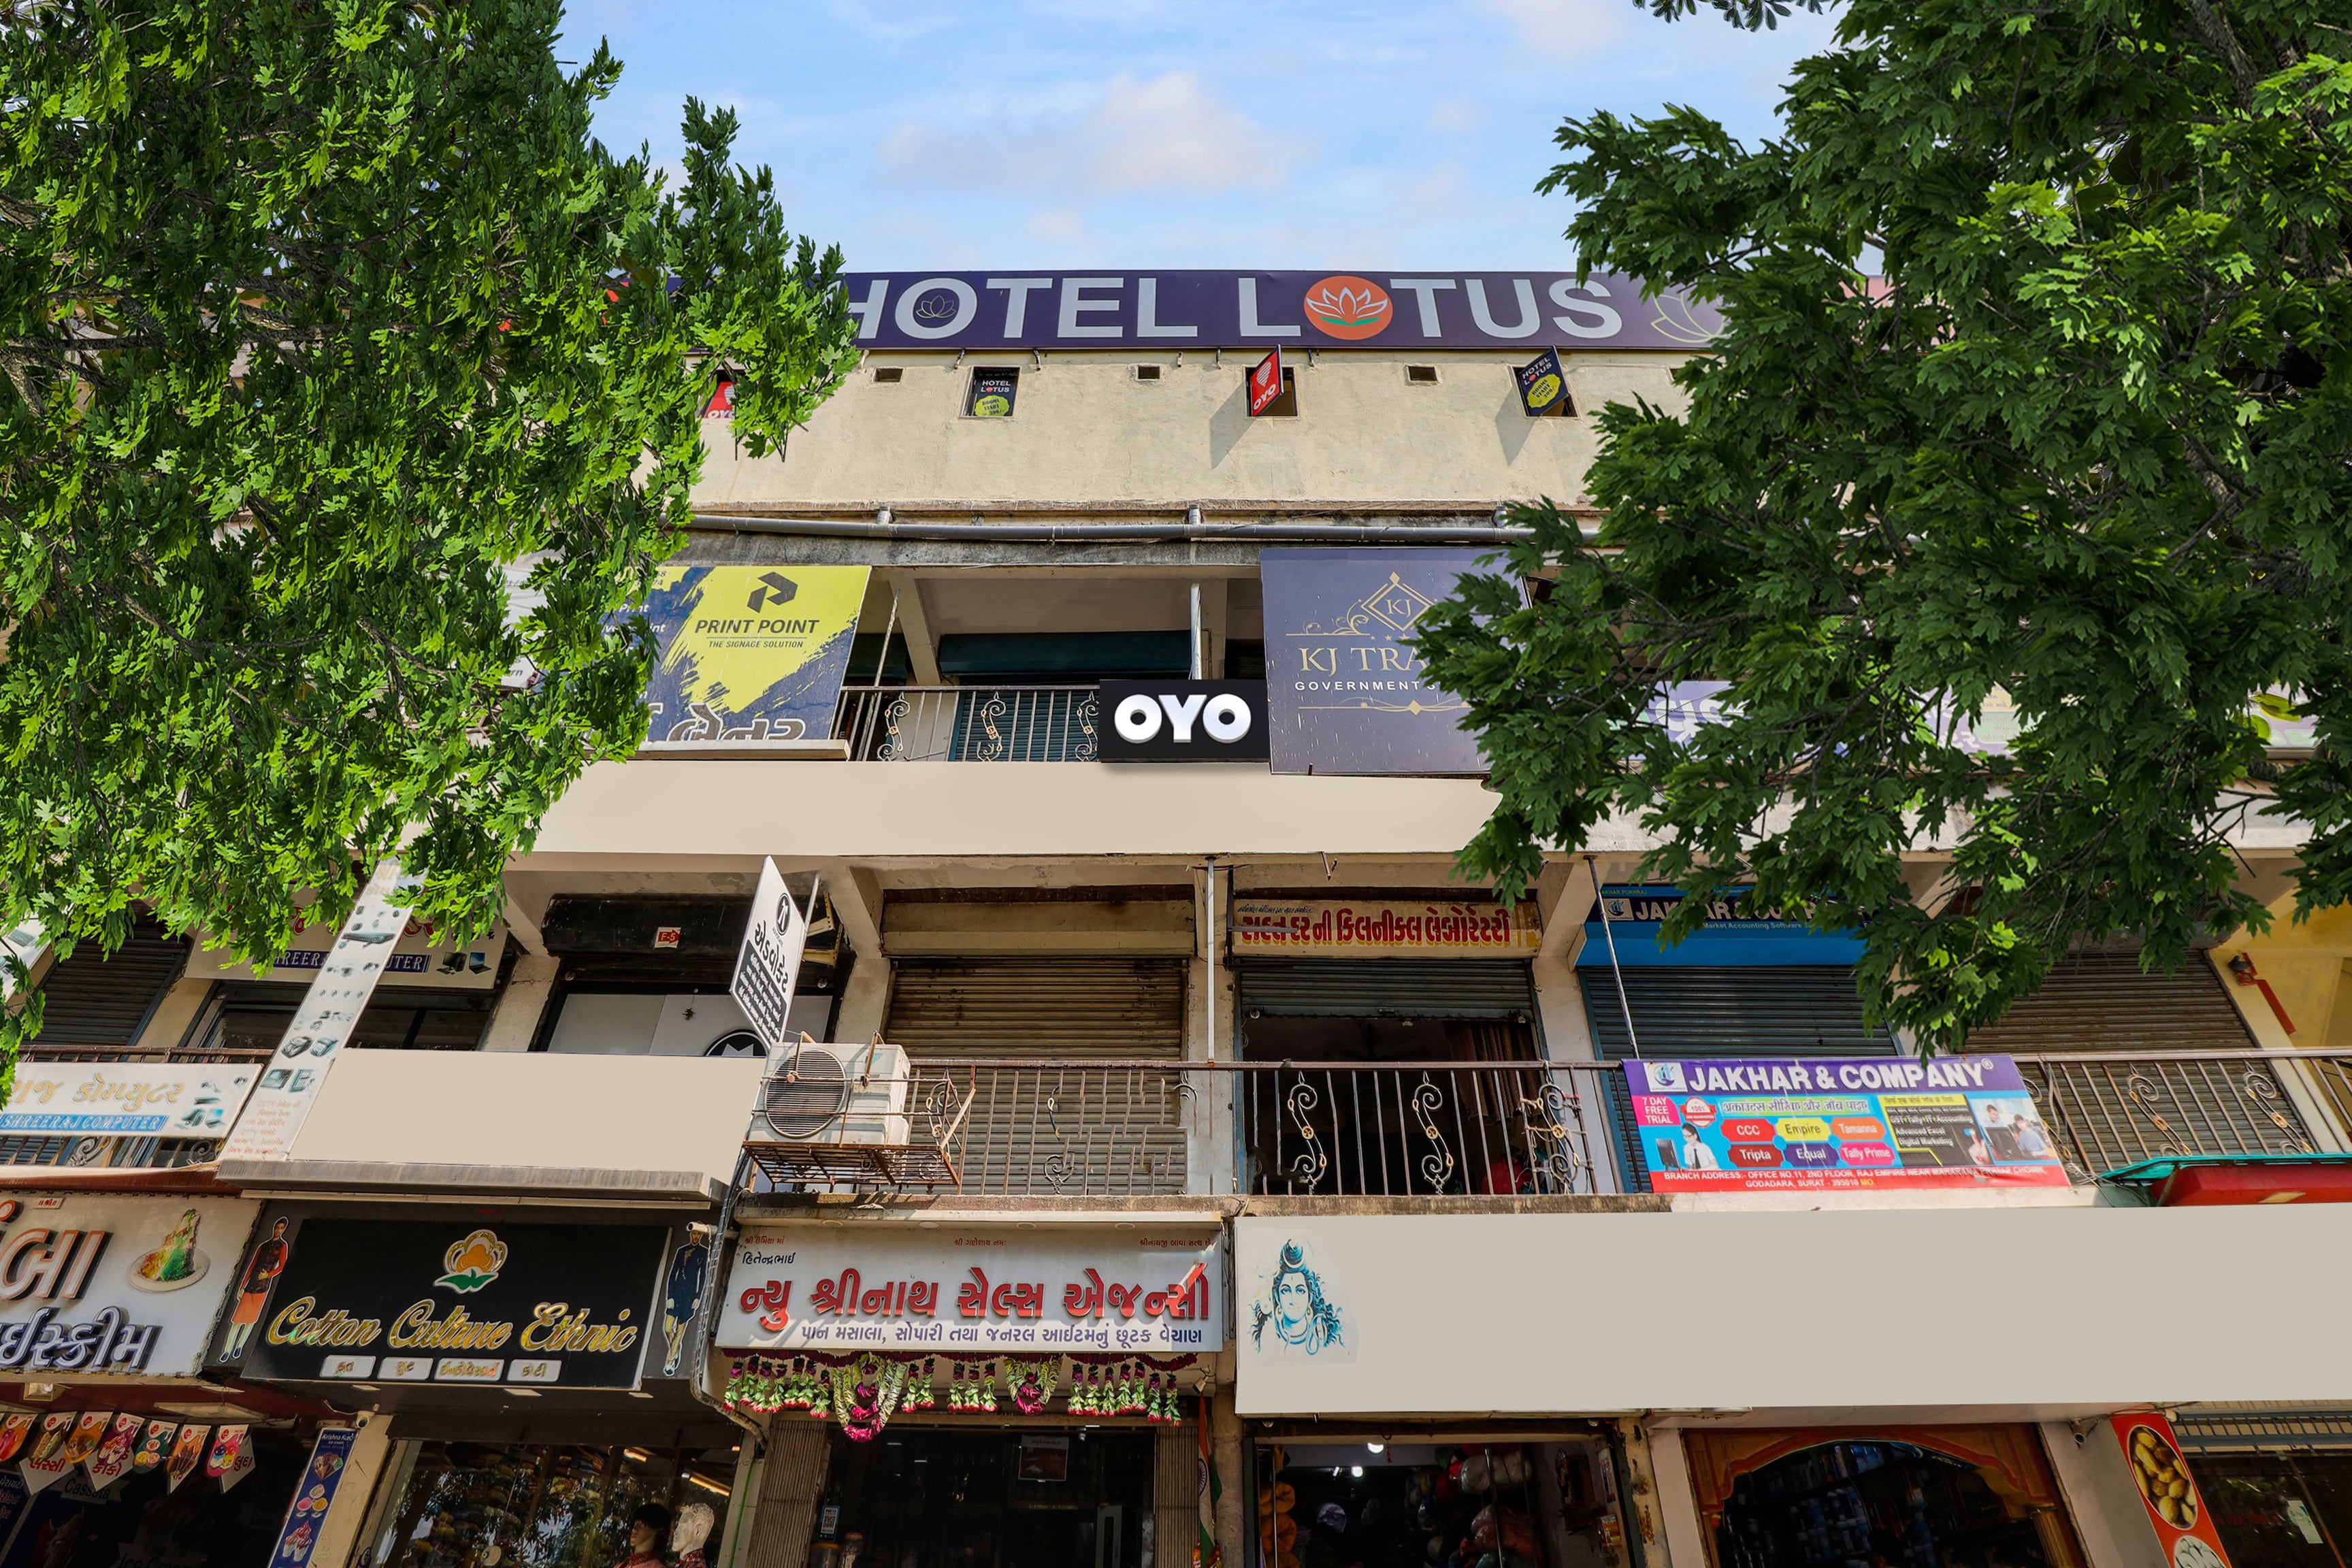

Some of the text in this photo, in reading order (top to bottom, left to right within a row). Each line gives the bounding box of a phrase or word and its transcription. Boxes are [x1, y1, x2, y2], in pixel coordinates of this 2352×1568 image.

[828, 277, 1198, 339] HOTEL
[1522, 357, 1550, 379] HOTEL
[1254, 384, 1276, 410] OYO
[1386, 598, 1412, 617] KJ
[694, 619, 819, 634] PRINT POINT
[1298, 647, 1427, 677] KJ TRA
[1294, 681, 1420, 691] GOVERNMENT
[1114, 693, 1252, 743] OYO
[1635, 901, 1731, 919] JAKAR
[755, 920, 788, 993] એડવોકેટ
[1689, 1066, 1813, 1092] JAKHAR
[1815, 1066, 1838, 1090] &
[1642, 1097, 1667, 1105] 7 DAY
[1803, 1098, 1821, 1112] और
[1645, 1106, 1669, 1114] FREE
[5, 1115, 161, 1130] SHREERAJ COMPUTER
[1645, 1115, 1673, 1124] TRIAL
[1737, 1122, 1878, 1136] CCC Empire Tamanna
[1740, 1147, 1891, 1162] Tripta Equal Tally Prime
[1664, 1172, 1700, 1181] BRANCH
[1748, 1171, 1778, 1179] OFFICE
[1857, 1169, 1874, 1177] RAJ
[1875, 1169, 1906, 1177] EMPIRE
[1907, 1168, 1931, 1176] NEAR
[1797, 1179, 1825, 1188] SURAT
[954, 1237, 963, 1246] શ્રી
[966, 1237, 991, 1246] ગણેશાય
[810, 1268, 939, 1317] શ્રીનાથ
[957, 1267, 1045, 1318] સેલ્સ
[266, 1295, 638, 1353] Cotton Culture Ethnic
[802, 1326, 829, 1341] પાન
[896, 1322, 943, 1341] સોપારી
[949, 1327, 978, 1342] તથા
[986, 1328, 1034, 1342] જનરલ
[1160, 1324, 1202, 1343] વેચાણ
